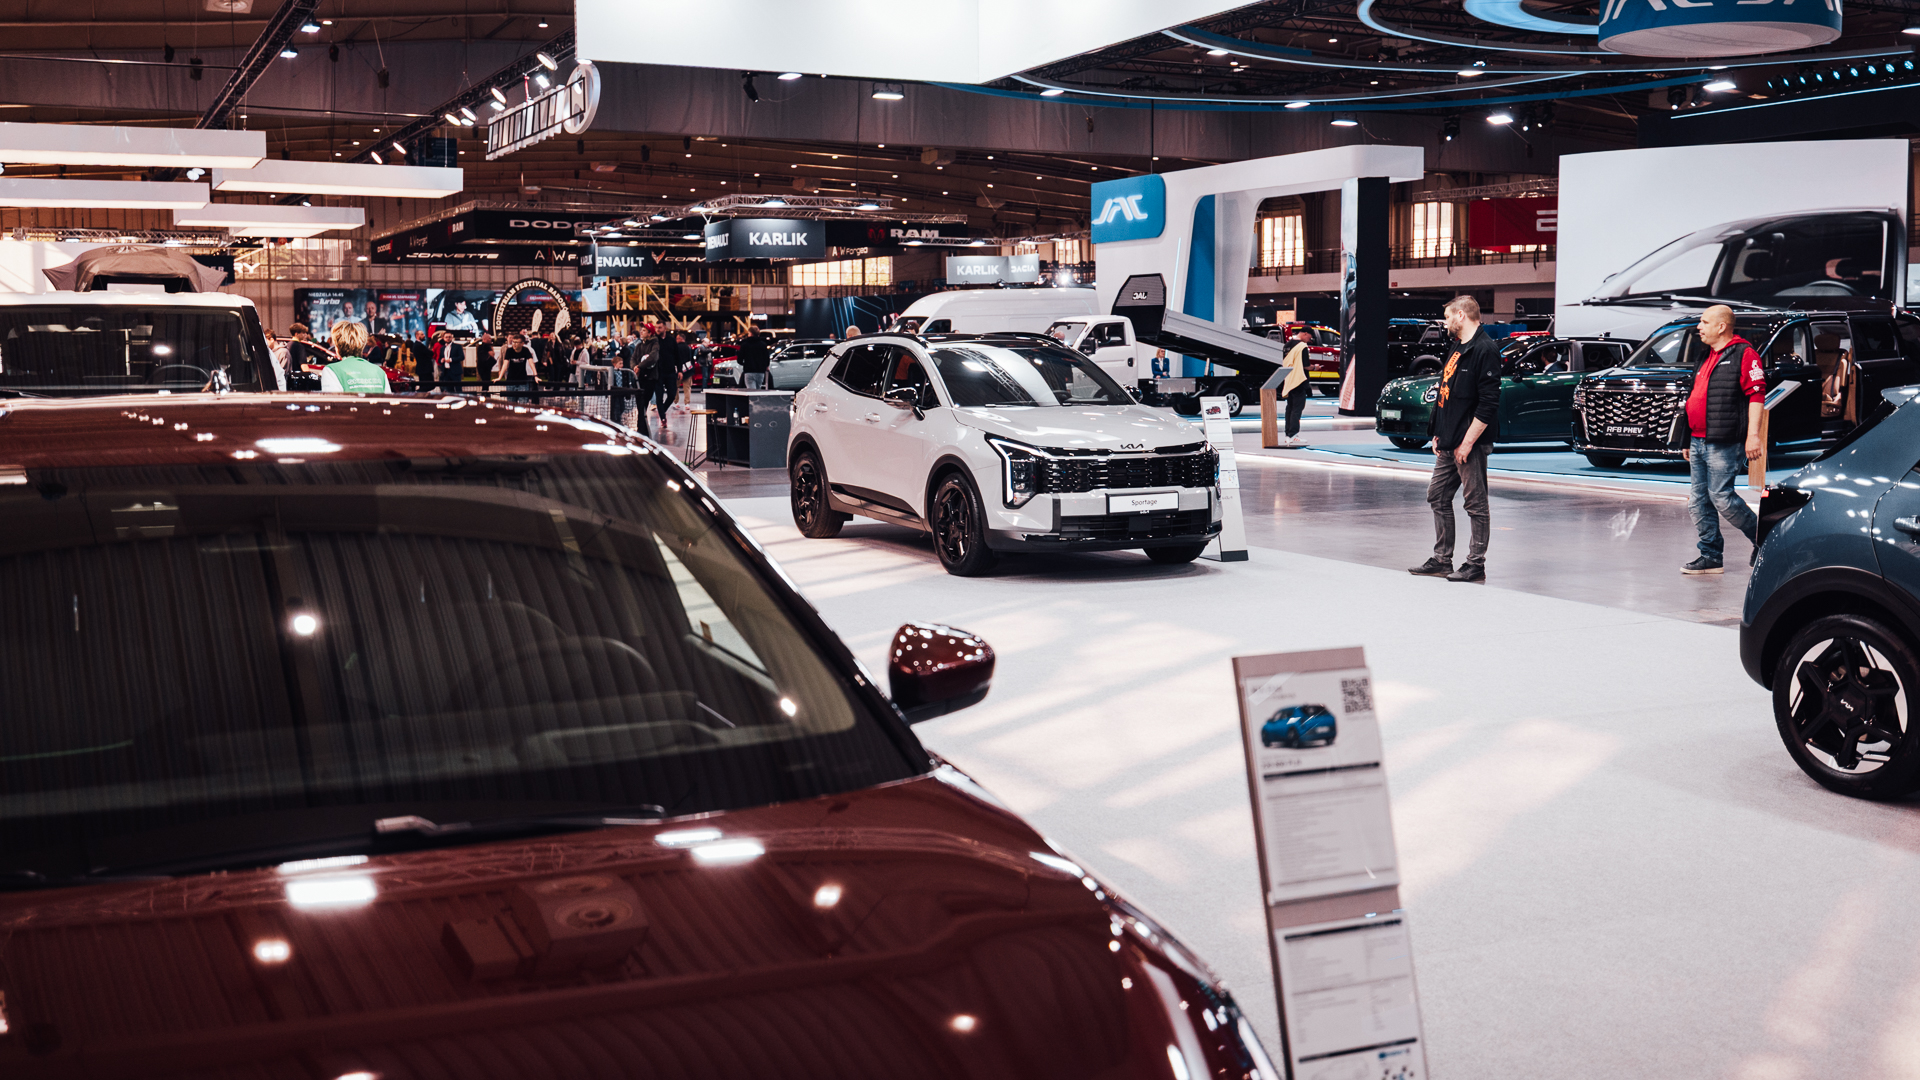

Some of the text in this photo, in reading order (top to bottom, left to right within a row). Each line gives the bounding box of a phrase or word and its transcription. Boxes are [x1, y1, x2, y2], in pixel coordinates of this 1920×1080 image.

[1091, 194, 1148, 225] JAC
[452, 221, 464, 233] RAM
[749, 232, 808, 246] KARLIK
[890, 229, 939, 238] RAM
[707, 233, 729, 250] RENAULT
[377, 243, 391, 253] DODGE
[597, 256, 645, 268] ENAULT
[956, 264, 1000, 276] KARLIK
[1011, 264, 1036, 274] DACIA
[495, 286, 517, 331] EQUESTRIAN
[515, 280, 548, 292] FESTIVAL
[1623, 426, 1643, 434] PHEV
[1131, 499, 1158, 507] Sportage
